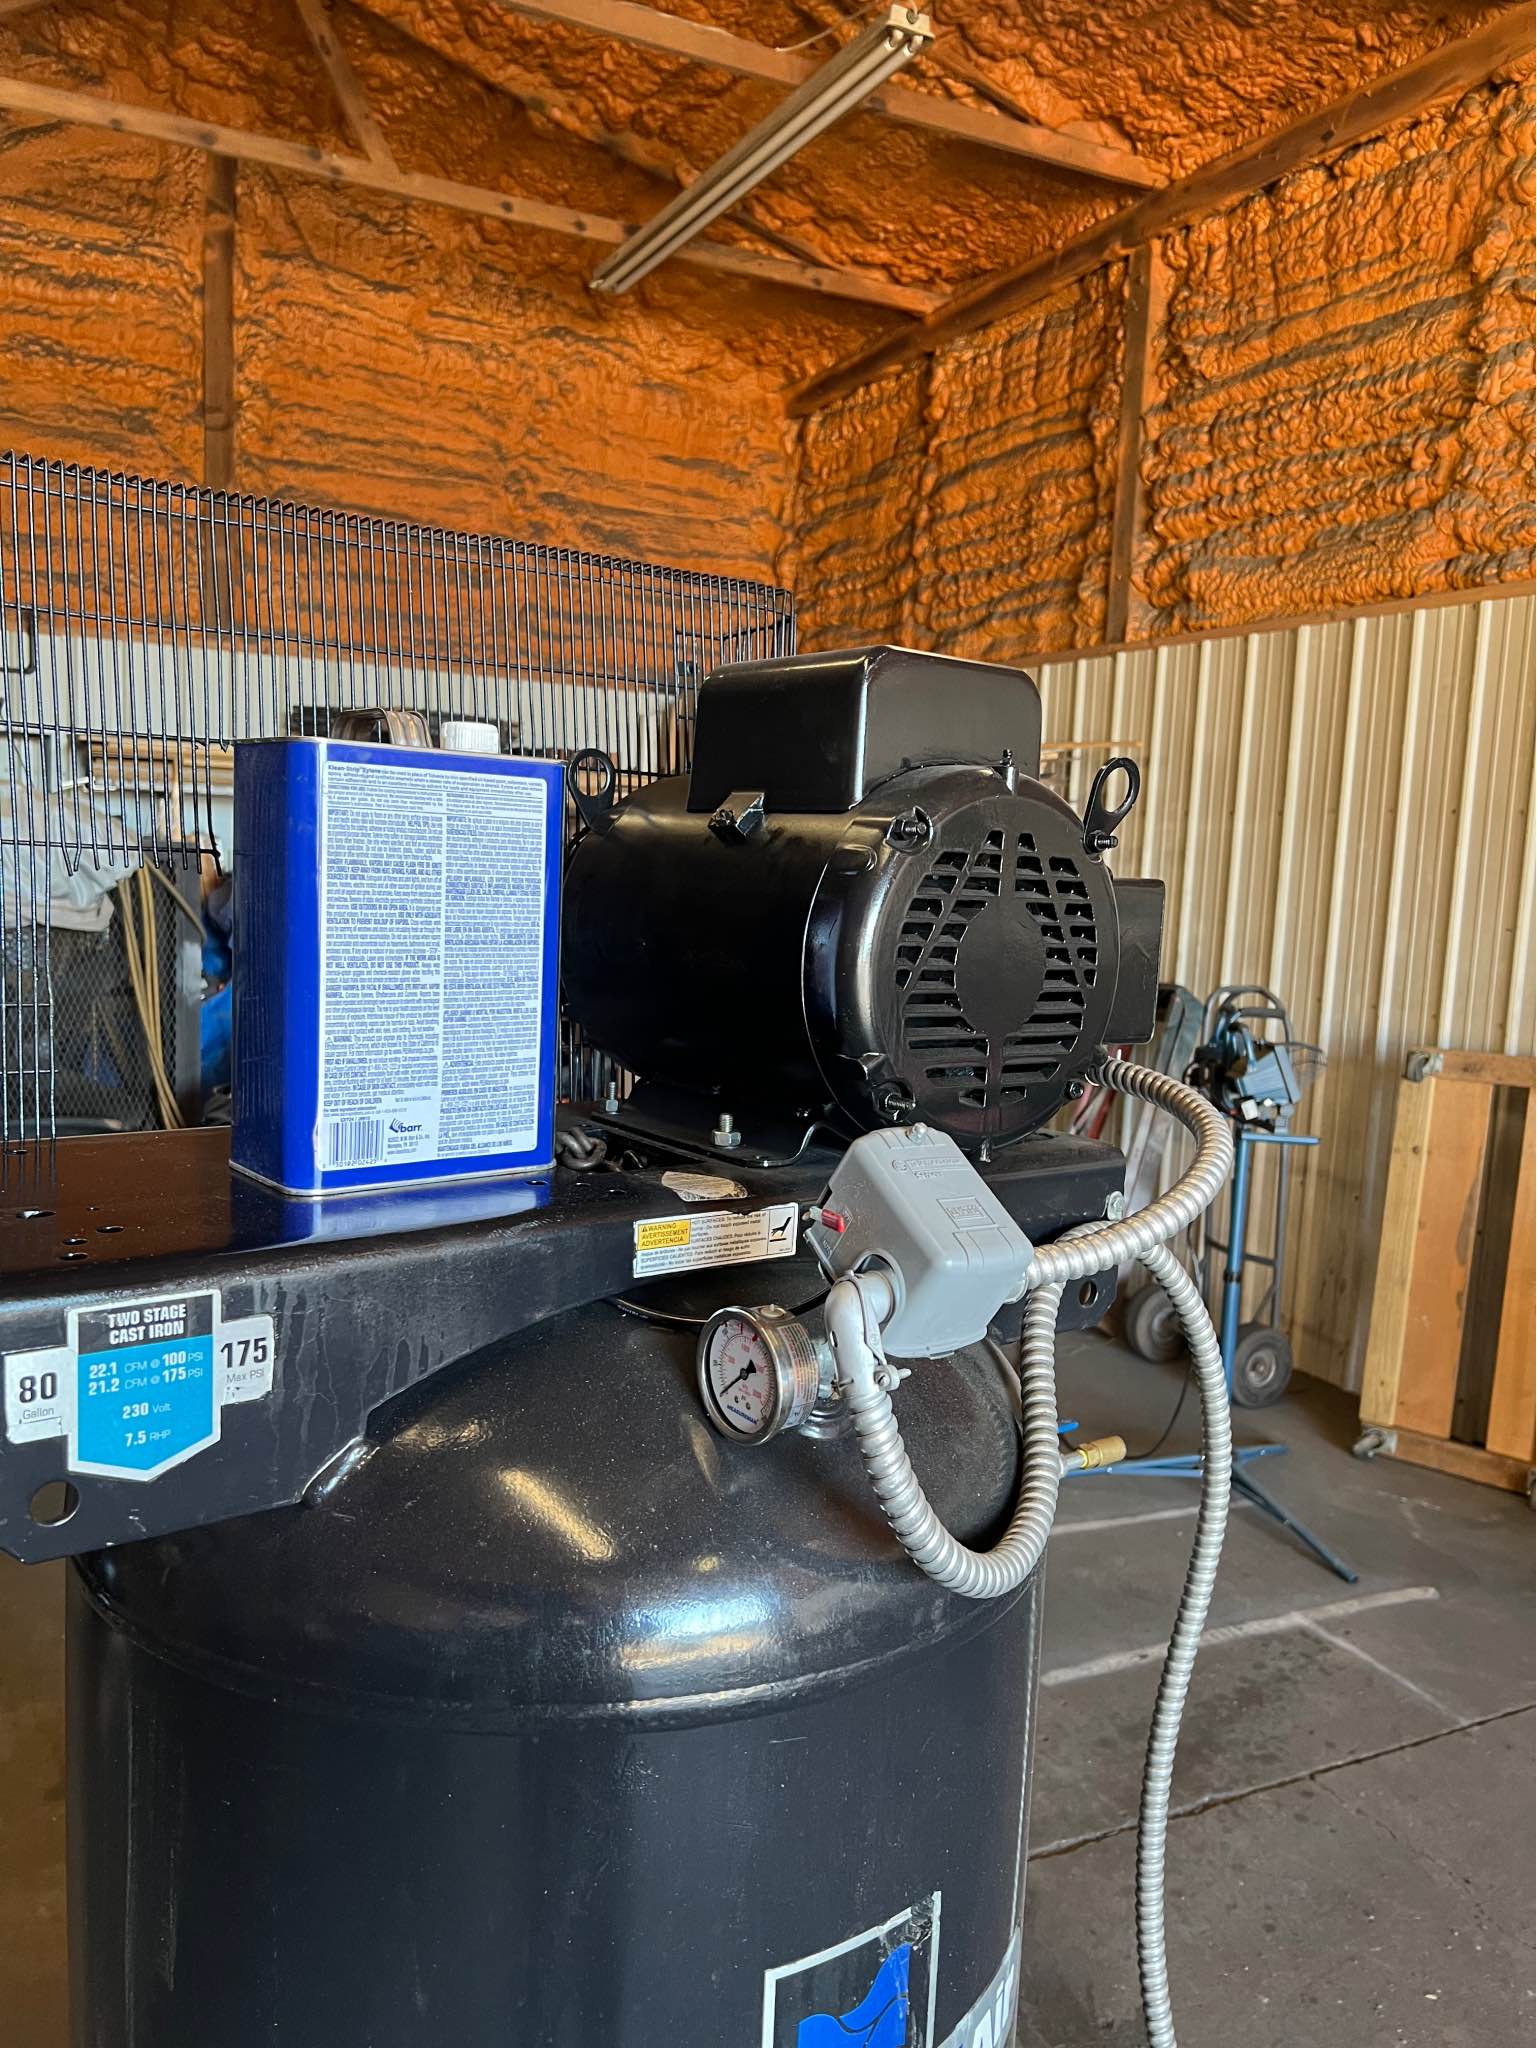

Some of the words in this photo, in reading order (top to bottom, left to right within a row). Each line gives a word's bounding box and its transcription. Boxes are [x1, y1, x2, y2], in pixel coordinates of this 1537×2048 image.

[400, 1122, 422, 1133] barr
[642, 1228, 688, 1240] AVERTISSEMENT
[648, 1222, 676, 1232] WARNING
[642, 1236, 684, 1247] ADVERTENCIA
[108, 1310, 140, 1328] TWO
[143, 1304, 186, 1323] STAGE
[109, 1326, 146, 1345] CAST
[148, 1320, 184, 1339] IRON
[220, 1337, 267, 1369] 175
[89, 1361, 117, 1379] 22.1
[124, 1360, 148, 1374] CFM
[162, 1350, 187, 1367] 100
[187, 1351, 204, 1363] PSI
[88, 1377, 120, 1396] 21.2
[124, 1378, 148, 1390] CFM
[162, 1366, 187, 1383] 175
[187, 1367, 204, 1379] PSI
[226, 1371, 248, 1384] Max
[249, 1368, 265, 1380] PSI
[19, 1371, 57, 1404] 80
[22, 1406, 55, 1421] Gallon
[122, 1402, 149, 1419] 230
[152, 1402, 172, 1414] Volt
[125, 1430, 147, 1447] 7.5
[150, 1429, 172, 1441] RHP
